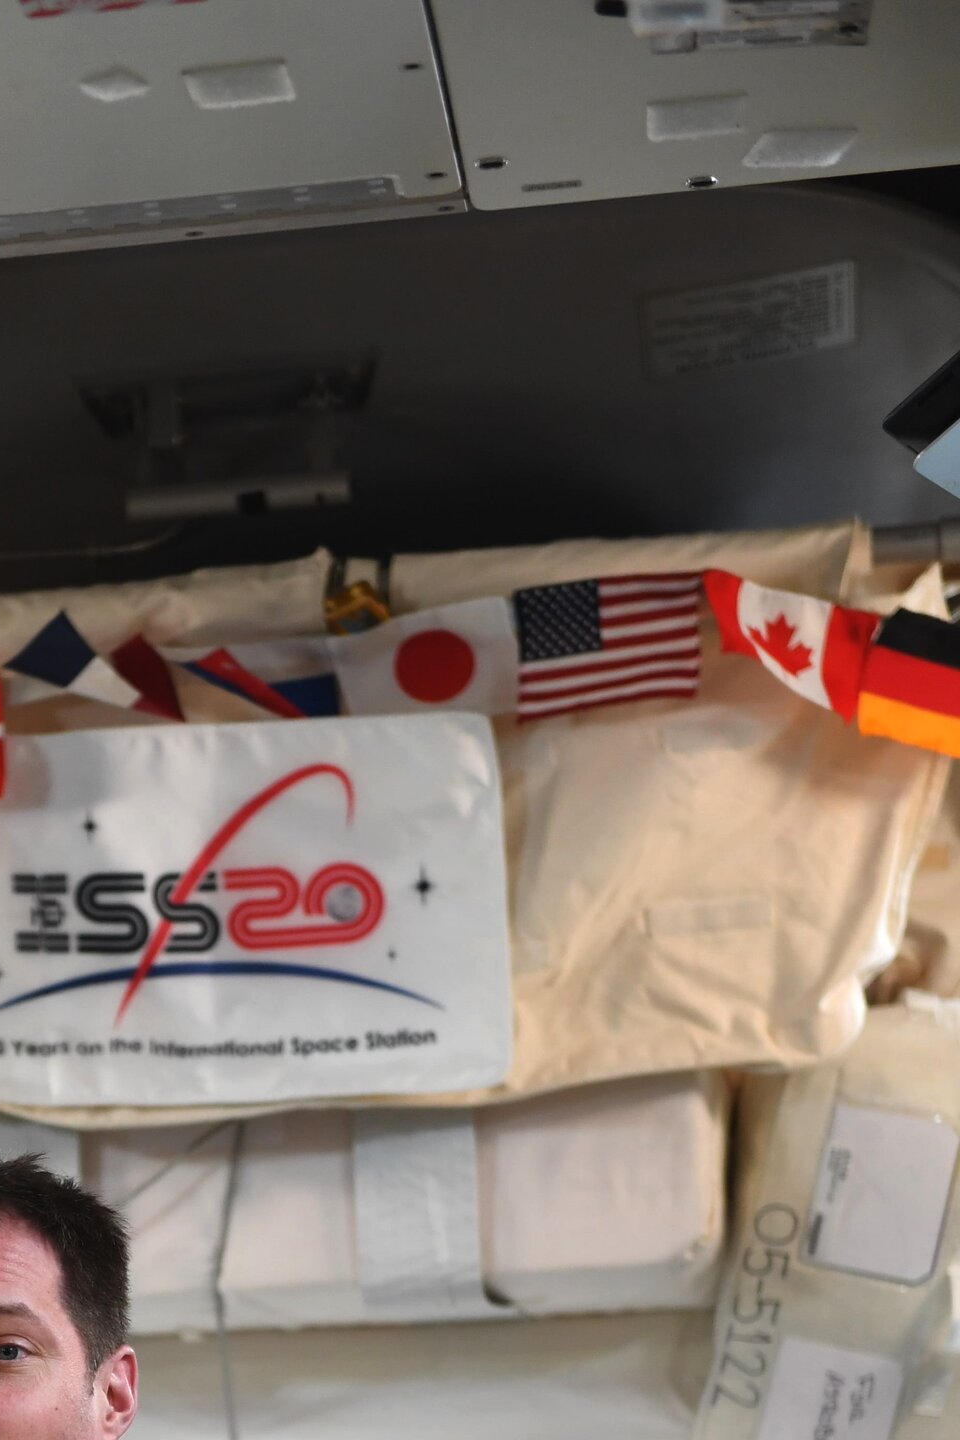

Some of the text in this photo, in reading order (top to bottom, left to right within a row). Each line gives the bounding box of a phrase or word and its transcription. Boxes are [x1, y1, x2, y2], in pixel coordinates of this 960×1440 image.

[13, 1039, 70, 1059] Years
[76, 1043, 103, 1058] on
[109, 1038, 142, 1056] the
[149, 1037, 284, 1059] International
[291, 1035, 358, 1058] Space
[366, 1027, 437, 1051] Station
